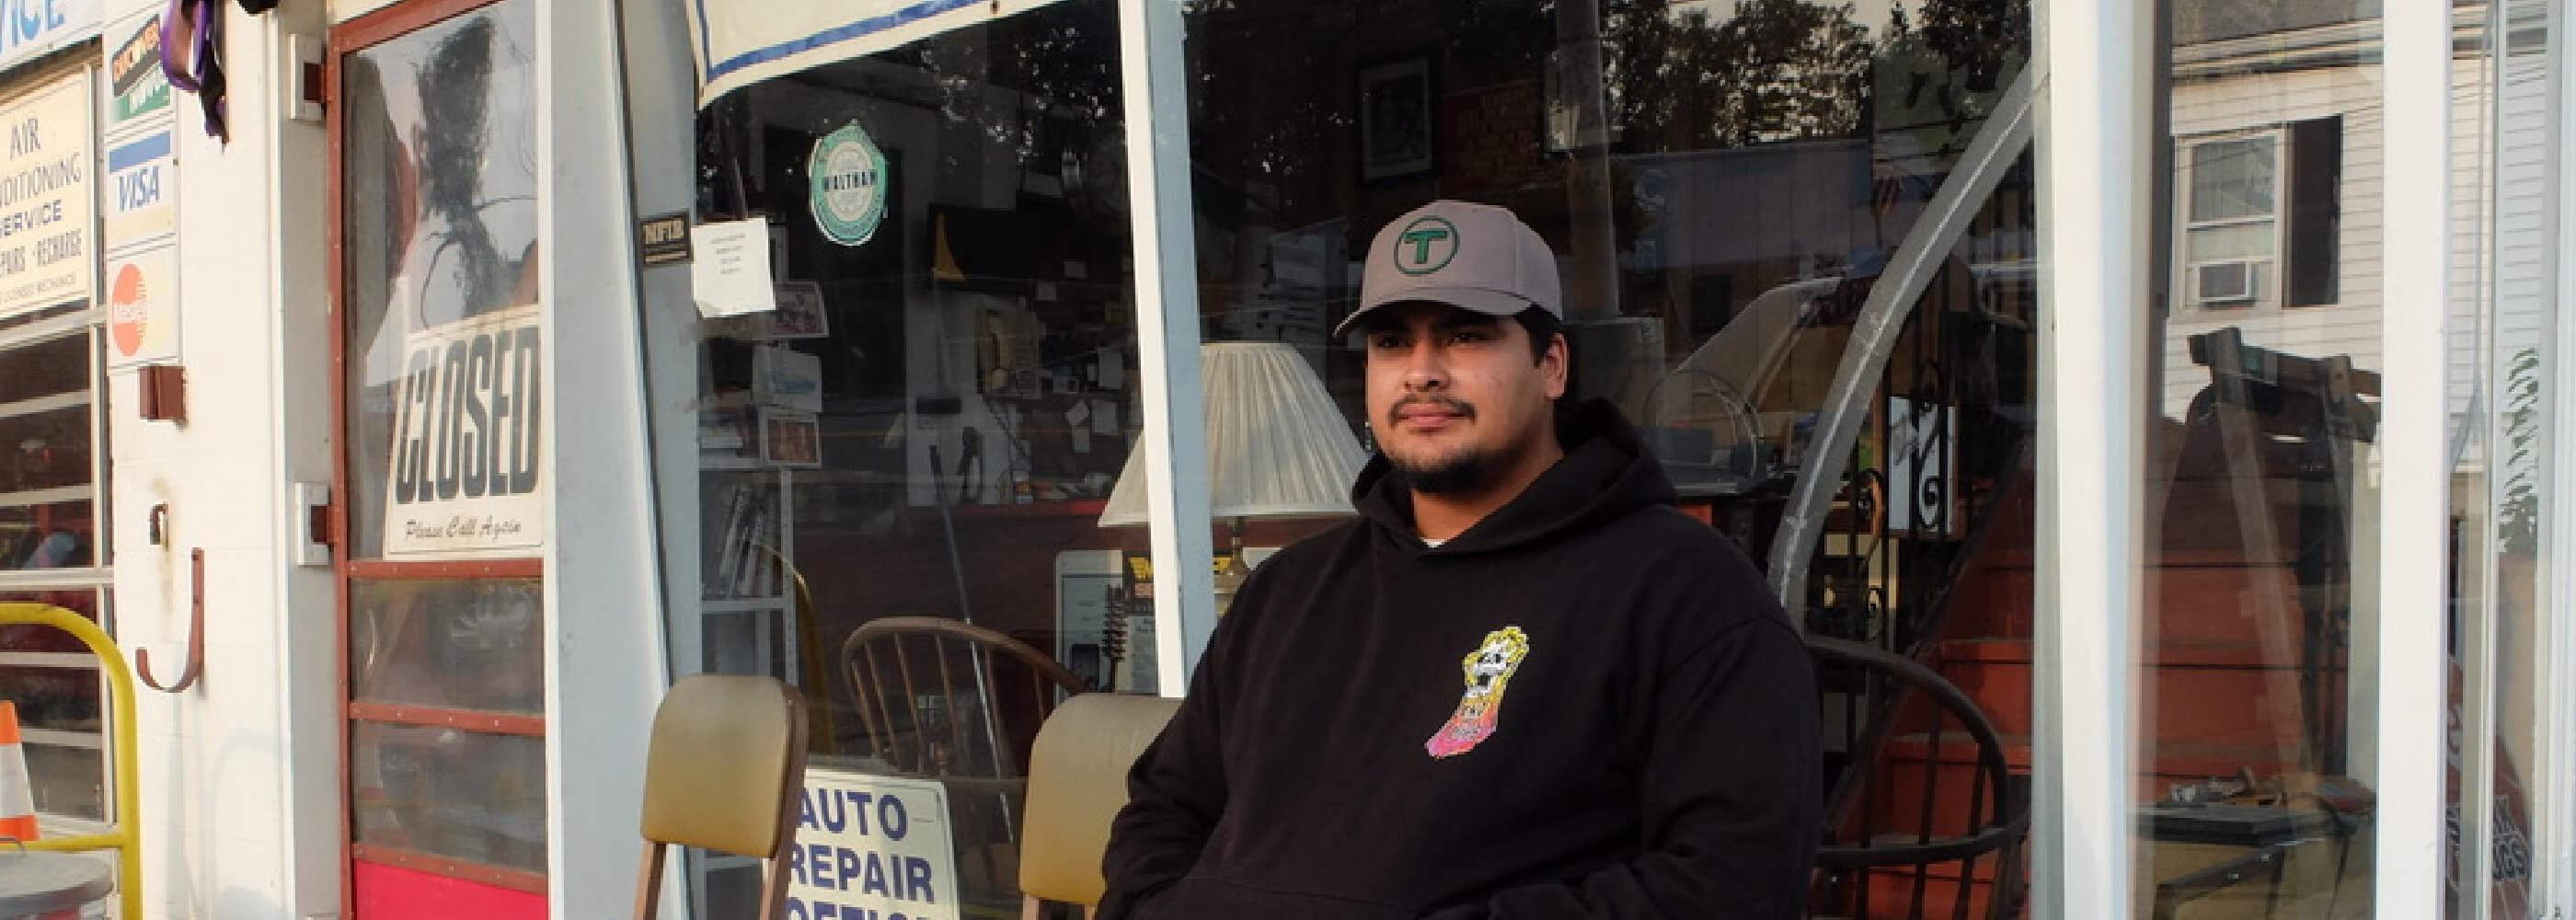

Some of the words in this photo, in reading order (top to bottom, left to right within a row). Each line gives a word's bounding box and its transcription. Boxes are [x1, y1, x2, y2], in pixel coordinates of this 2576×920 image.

[0, 0, 64, 50] ICE
[10, 118, 40, 160] AIR
[120, 165, 160, 212] VISA
[822, 170, 878, 191] WALTHAM
[646, 220, 684, 244] NFIB
[1404, 230, 1447, 264] T
[396, 326, 539, 505] CLOSED
[405, 518, 443, 540] Please
[445, 515, 477, 538] Call
[478, 514, 522, 543] Again
[796, 788, 908, 841] AUTO
[790, 843, 935, 903] REPAIR
